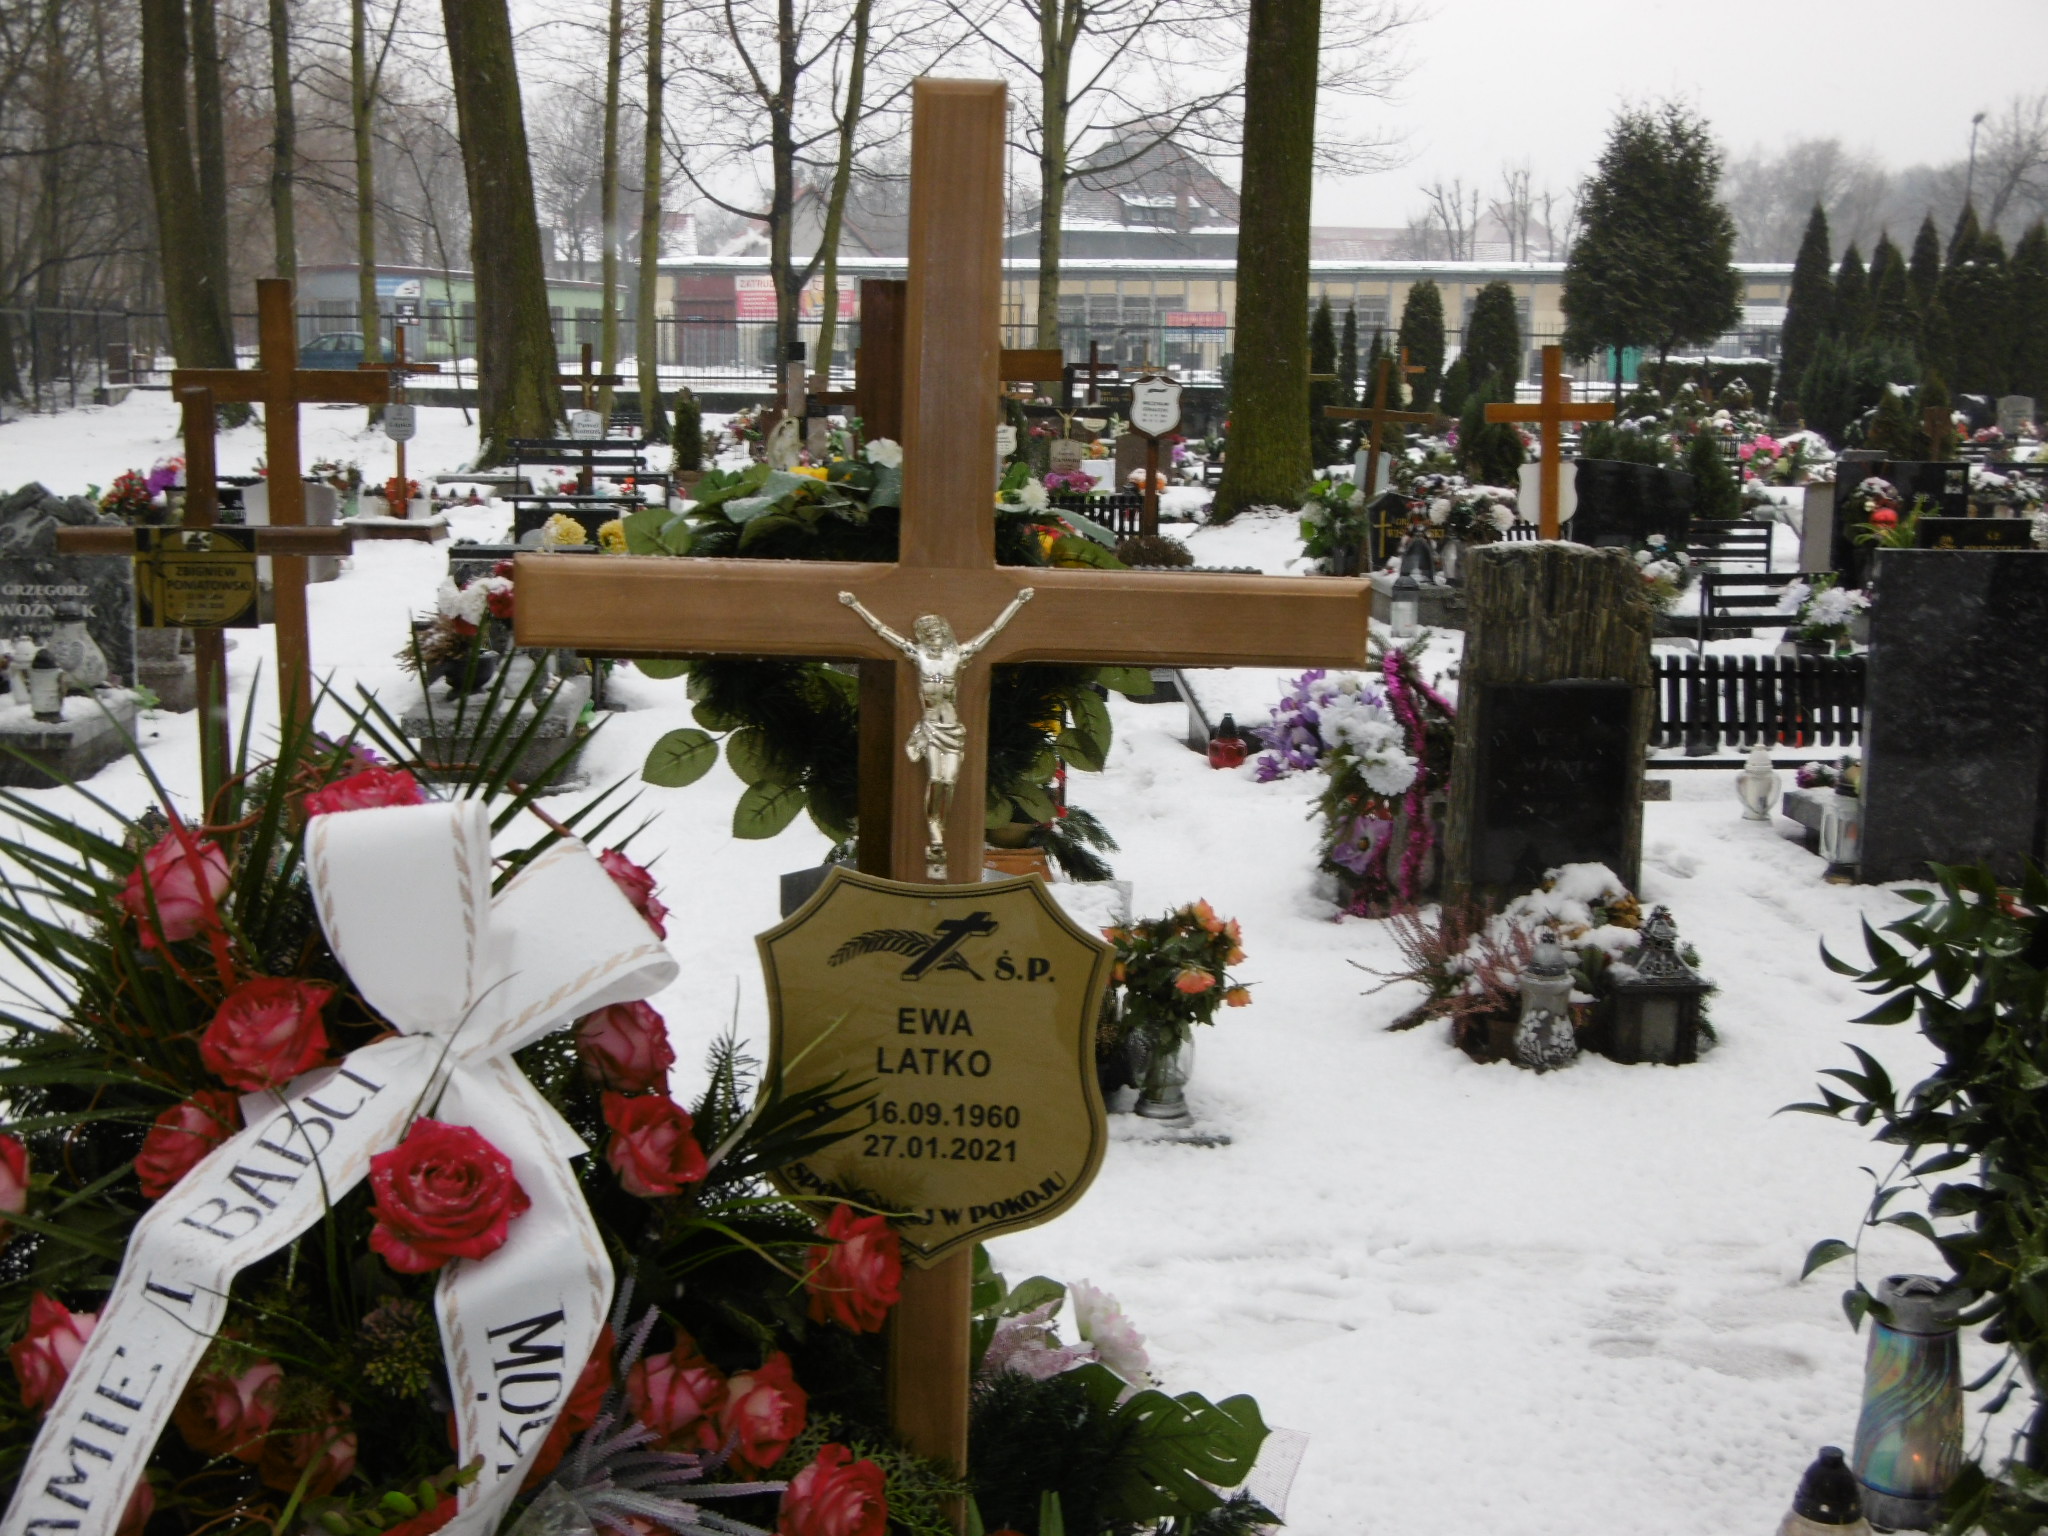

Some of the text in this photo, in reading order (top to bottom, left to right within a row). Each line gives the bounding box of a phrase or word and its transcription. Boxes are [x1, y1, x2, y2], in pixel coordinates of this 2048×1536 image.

[1, 584, 90, 597] GRZEGORZ
[0, 600, 97, 618] WOŹNK
[898, 1007, 973, 1036] EWA
[877, 1047, 991, 1078] LATKO
[865, 1101, 1021, 1129] 16.09.1960
[863, 1134, 1017, 1163] 27.01.2021
[968, 1170, 1067, 1224] POKOJU
